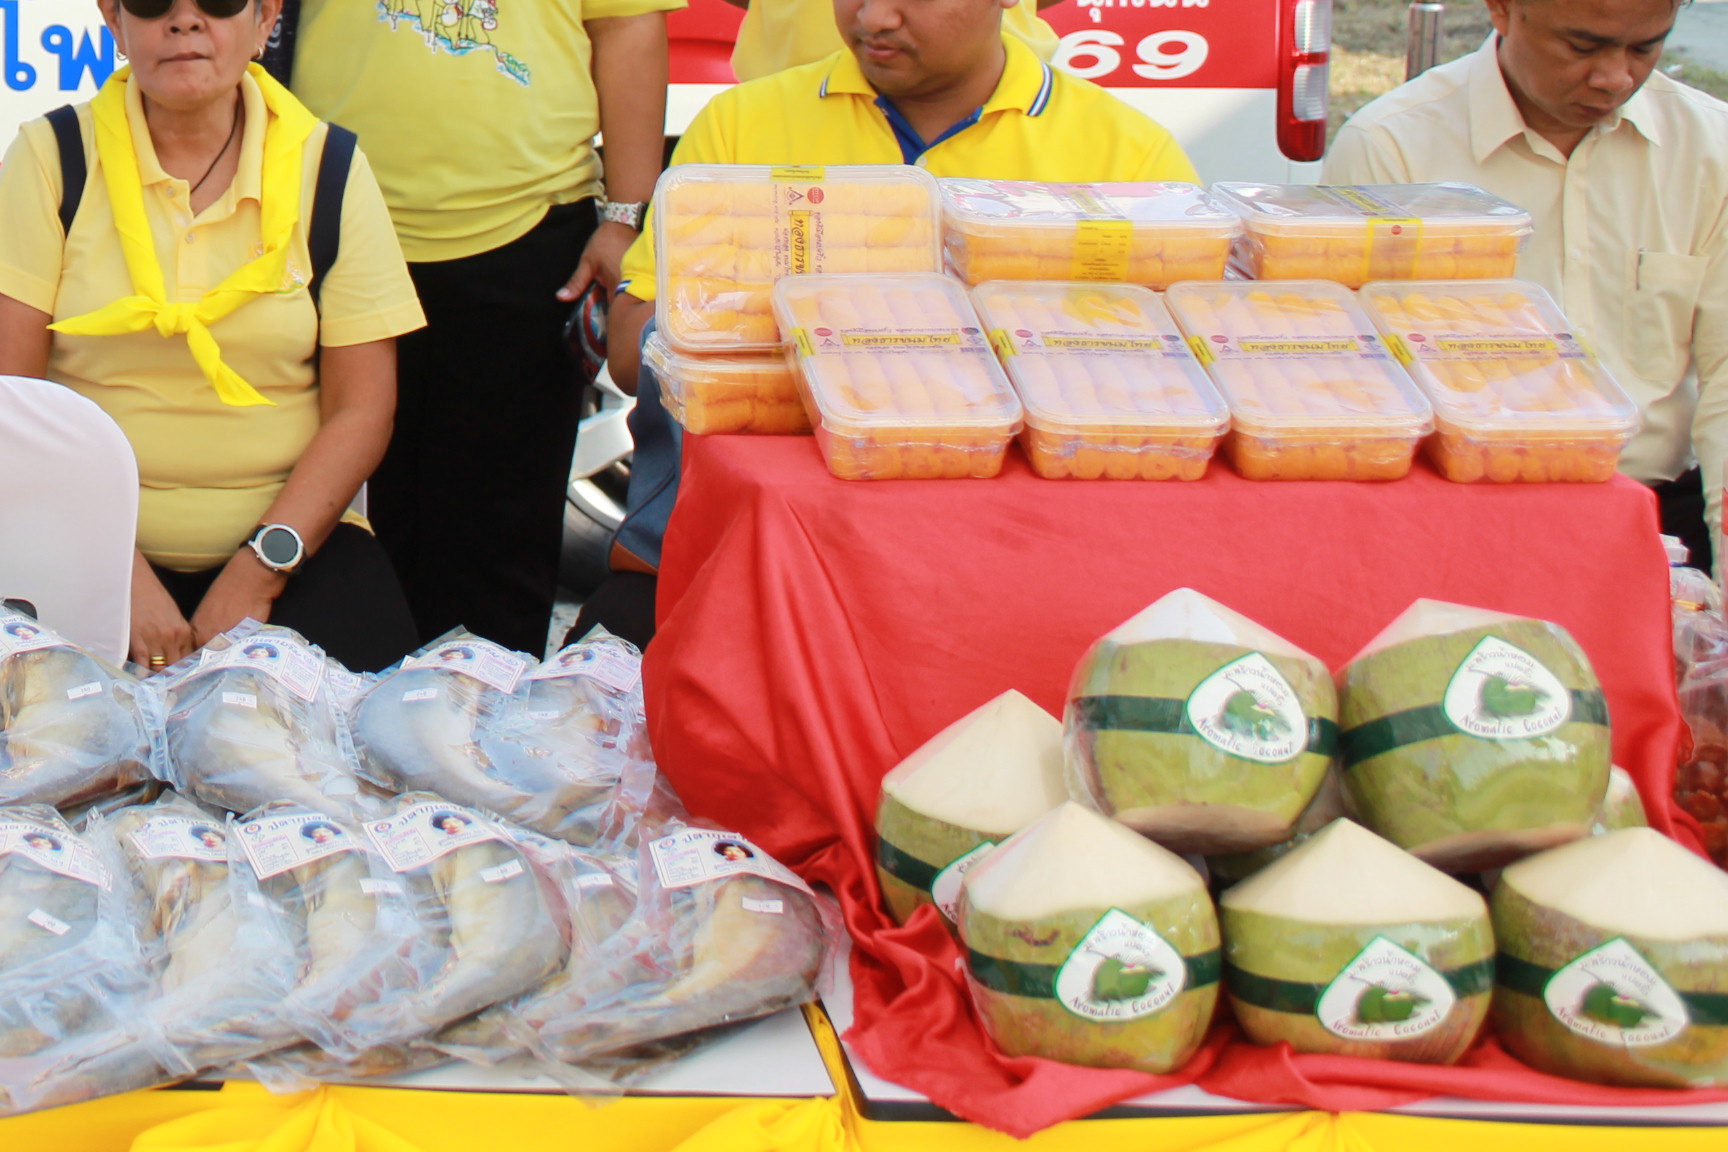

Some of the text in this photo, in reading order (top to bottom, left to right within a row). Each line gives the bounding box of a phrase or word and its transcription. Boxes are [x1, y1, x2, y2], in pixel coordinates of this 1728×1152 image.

[1050, 29, 1210, 80] 69
[1197, 717, 1241, 751] Aromatic
[1460, 706, 1563, 735] Aromatic Coconut
[1070, 983, 1174, 1017] Aromatic Coconut
[1330, 1010, 1441, 1037] Aromatic Coconut
[1558, 1005, 1670, 1042] Aromatic Coconut
